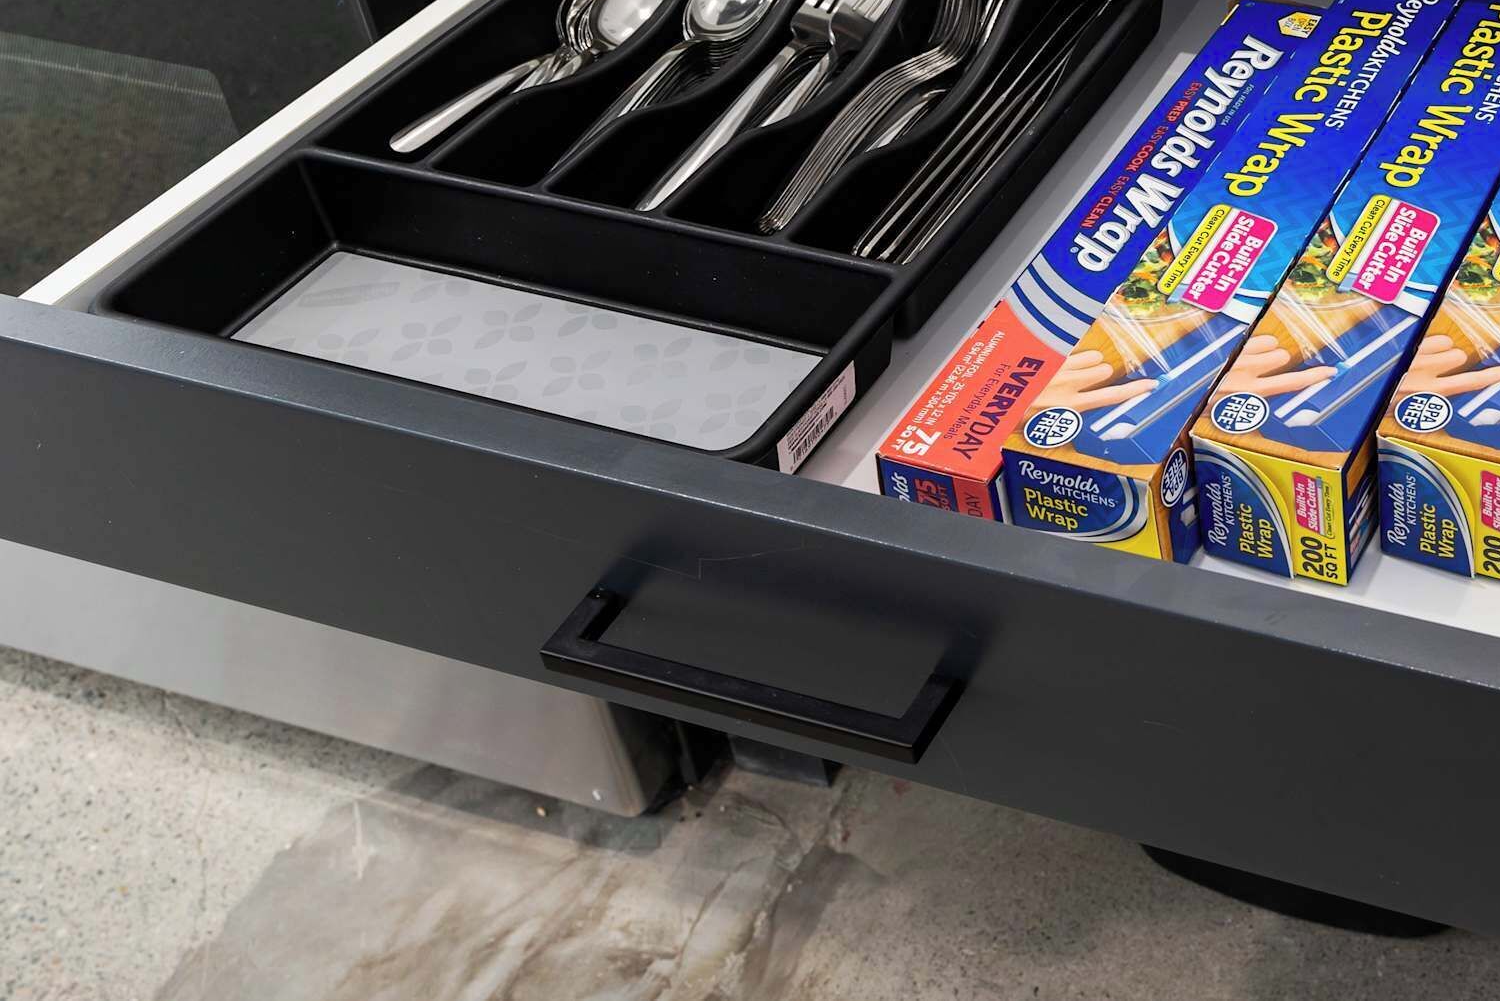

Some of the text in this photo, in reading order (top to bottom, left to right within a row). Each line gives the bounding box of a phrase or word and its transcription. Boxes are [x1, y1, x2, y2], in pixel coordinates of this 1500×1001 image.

[1223, 10, 1393, 198] Plastic Wrap
[1233, 94, 1246, 110] MADE
[1325, 57, 1386, 129] KITCHENS
[1220, 115, 1231, 126] USA
[1074, 34, 1284, 272] Reynolds Wrap
[1081, 81, 1202, 228] EASY PREP EASY COOK EASY CLEAN
[1379, 105, 1474, 189] Wrap
[1165, 208, 1225, 288] Clean Cut Every Time
[1189, 215, 1254, 300] Slide Cutter
[1333, 199, 1385, 277] Clean Cut Every Time
[1358, 206, 1417, 290] Slide Cutter
[1383, 226, 1428, 283] Built-In
[1214, 235, 1264, 292] Built-In
[974, 331, 1006, 365] ALUMINUM
[961, 363, 980, 378] FOIL
[942, 391, 959, 404] YDS
[943, 363, 1011, 440] For Everyday Meals
[952, 356, 1046, 461] EVERYDAY
[1217, 395, 1246, 425] FREE
[1236, 403, 1260, 423] BPA
[1401, 395, 1428, 425] FREE
[1421, 403, 1443, 422] BPA
[889, 424, 917, 451] SQ FT
[923, 417, 938, 426] IN
[1029, 411, 1061, 441] FREE
[1048, 417, 1074, 438] BPA
[902, 429, 942, 456] 75
[1018, 460, 1116, 507] Reynolds KITCHENS
[1024, 487, 1089, 517] Plastic
[1295, 482, 1307, 518] Built-In
[1482, 481, 1494, 517] Built-In
[1025, 502, 1078, 531] Wrap
[1206, 474, 1235, 546] Reynolds KITCHENS
[1237, 503, 1256, 554] Plastic
[1386, 474, 1417, 546] Reynolds KITCHENS
[1420, 503, 1437, 554] Plastic
[1256, 518, 1275, 559] Wrap
[1300, 536, 1325, 576] 200
[1438, 518, 1458, 558] Wrap
[1324, 543, 1338, 579] SQ FT
